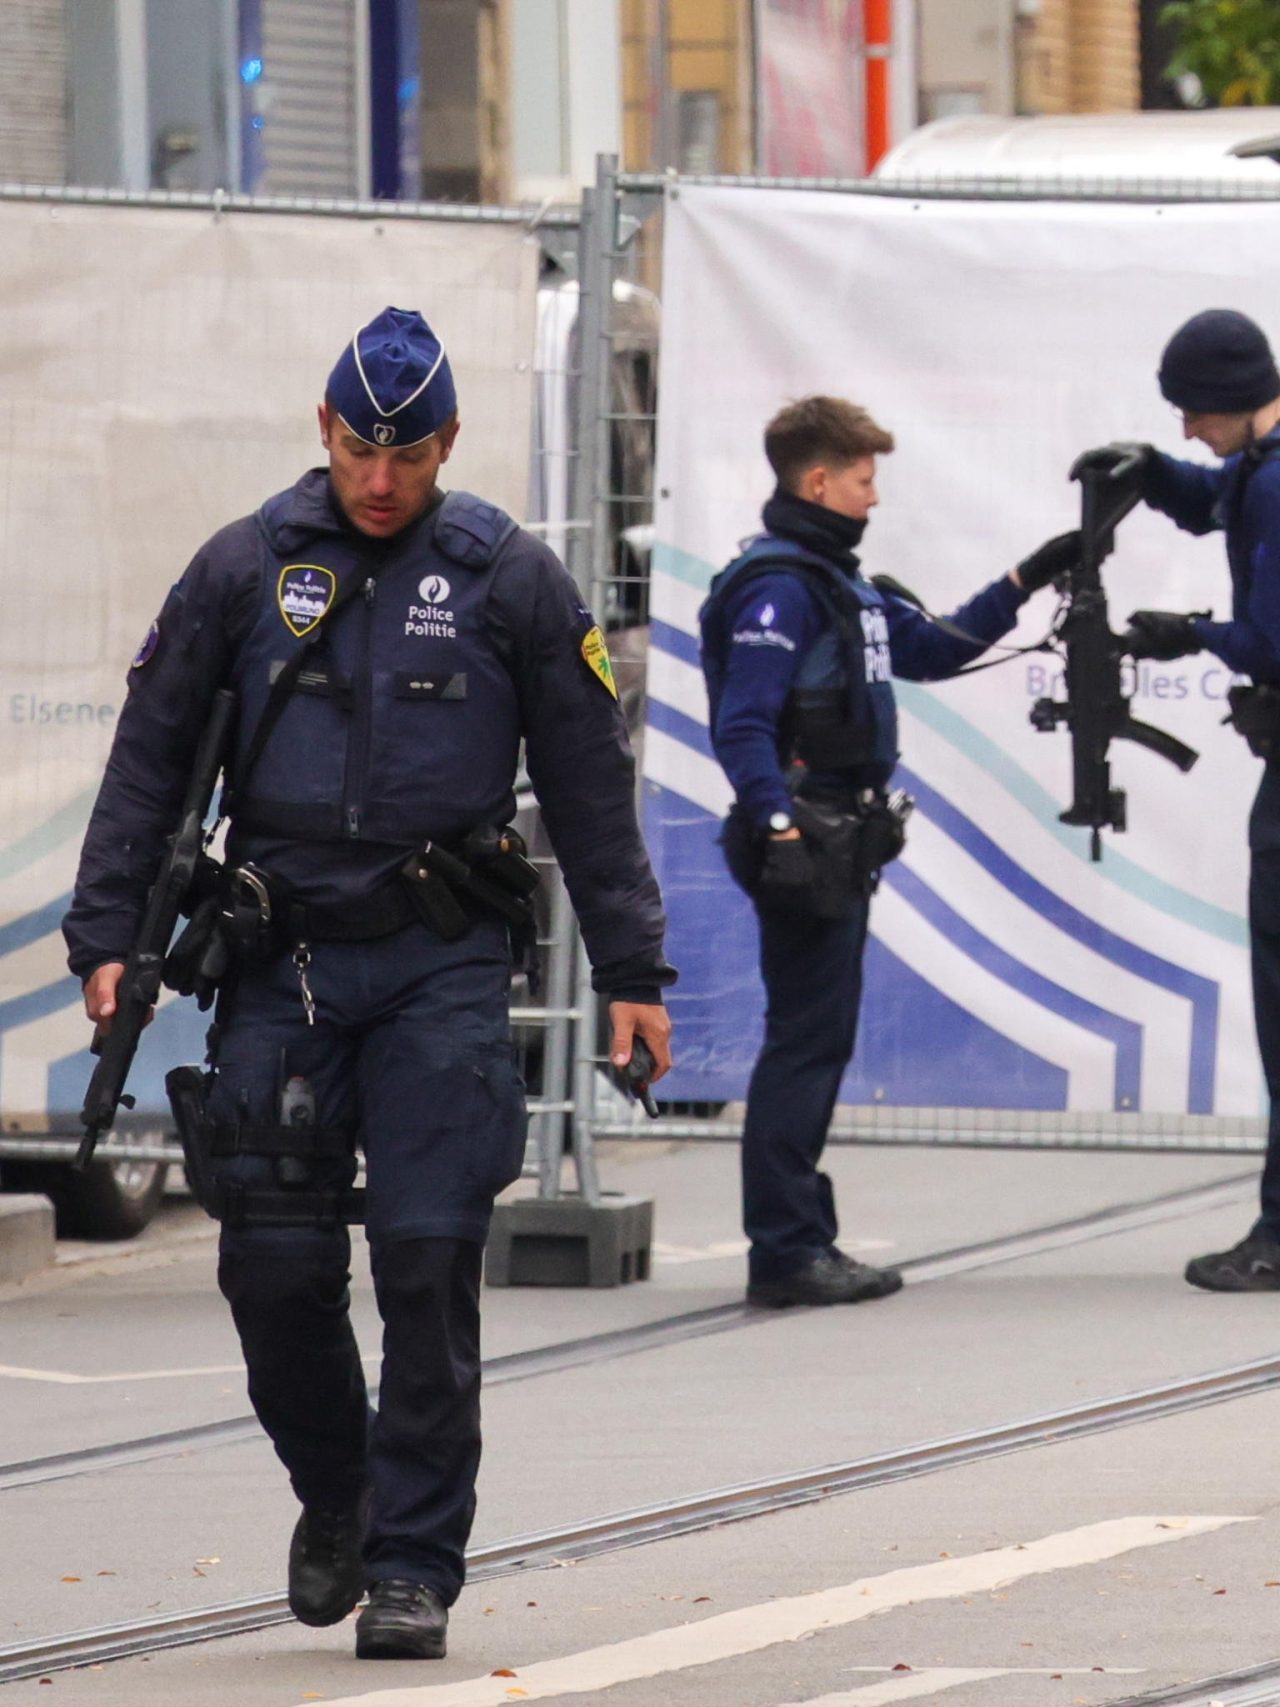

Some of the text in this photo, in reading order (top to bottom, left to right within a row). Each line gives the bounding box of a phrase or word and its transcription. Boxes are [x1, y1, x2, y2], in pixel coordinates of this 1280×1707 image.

[408, 605, 455, 622] Police
[405, 621, 457, 638] Politie
[1026, 664, 1189, 700] Brles
[9, 693, 115, 727] Elsene
